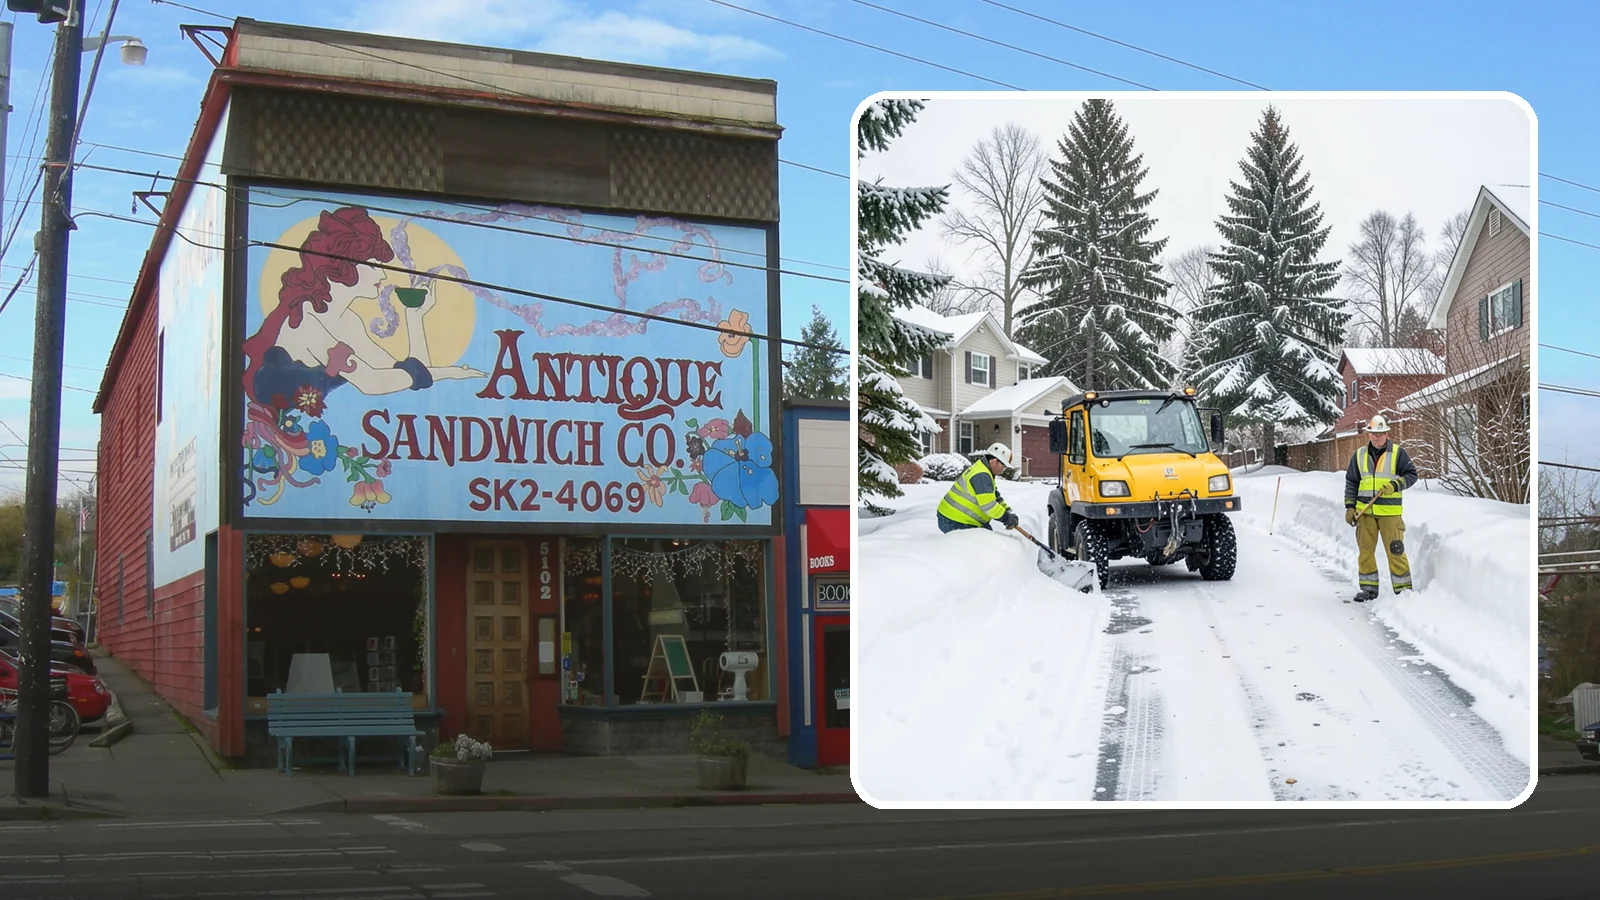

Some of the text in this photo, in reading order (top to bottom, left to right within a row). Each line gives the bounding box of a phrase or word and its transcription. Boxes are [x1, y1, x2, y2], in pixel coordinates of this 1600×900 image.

[475, 329, 723, 421] ANTIQUE
[361, 408, 685, 469] SANDWICH CO.
[468, 477, 646, 513] SK2-4069
[540, 541, 552, 600] 5102
[809, 555, 835, 569] BOOKS
